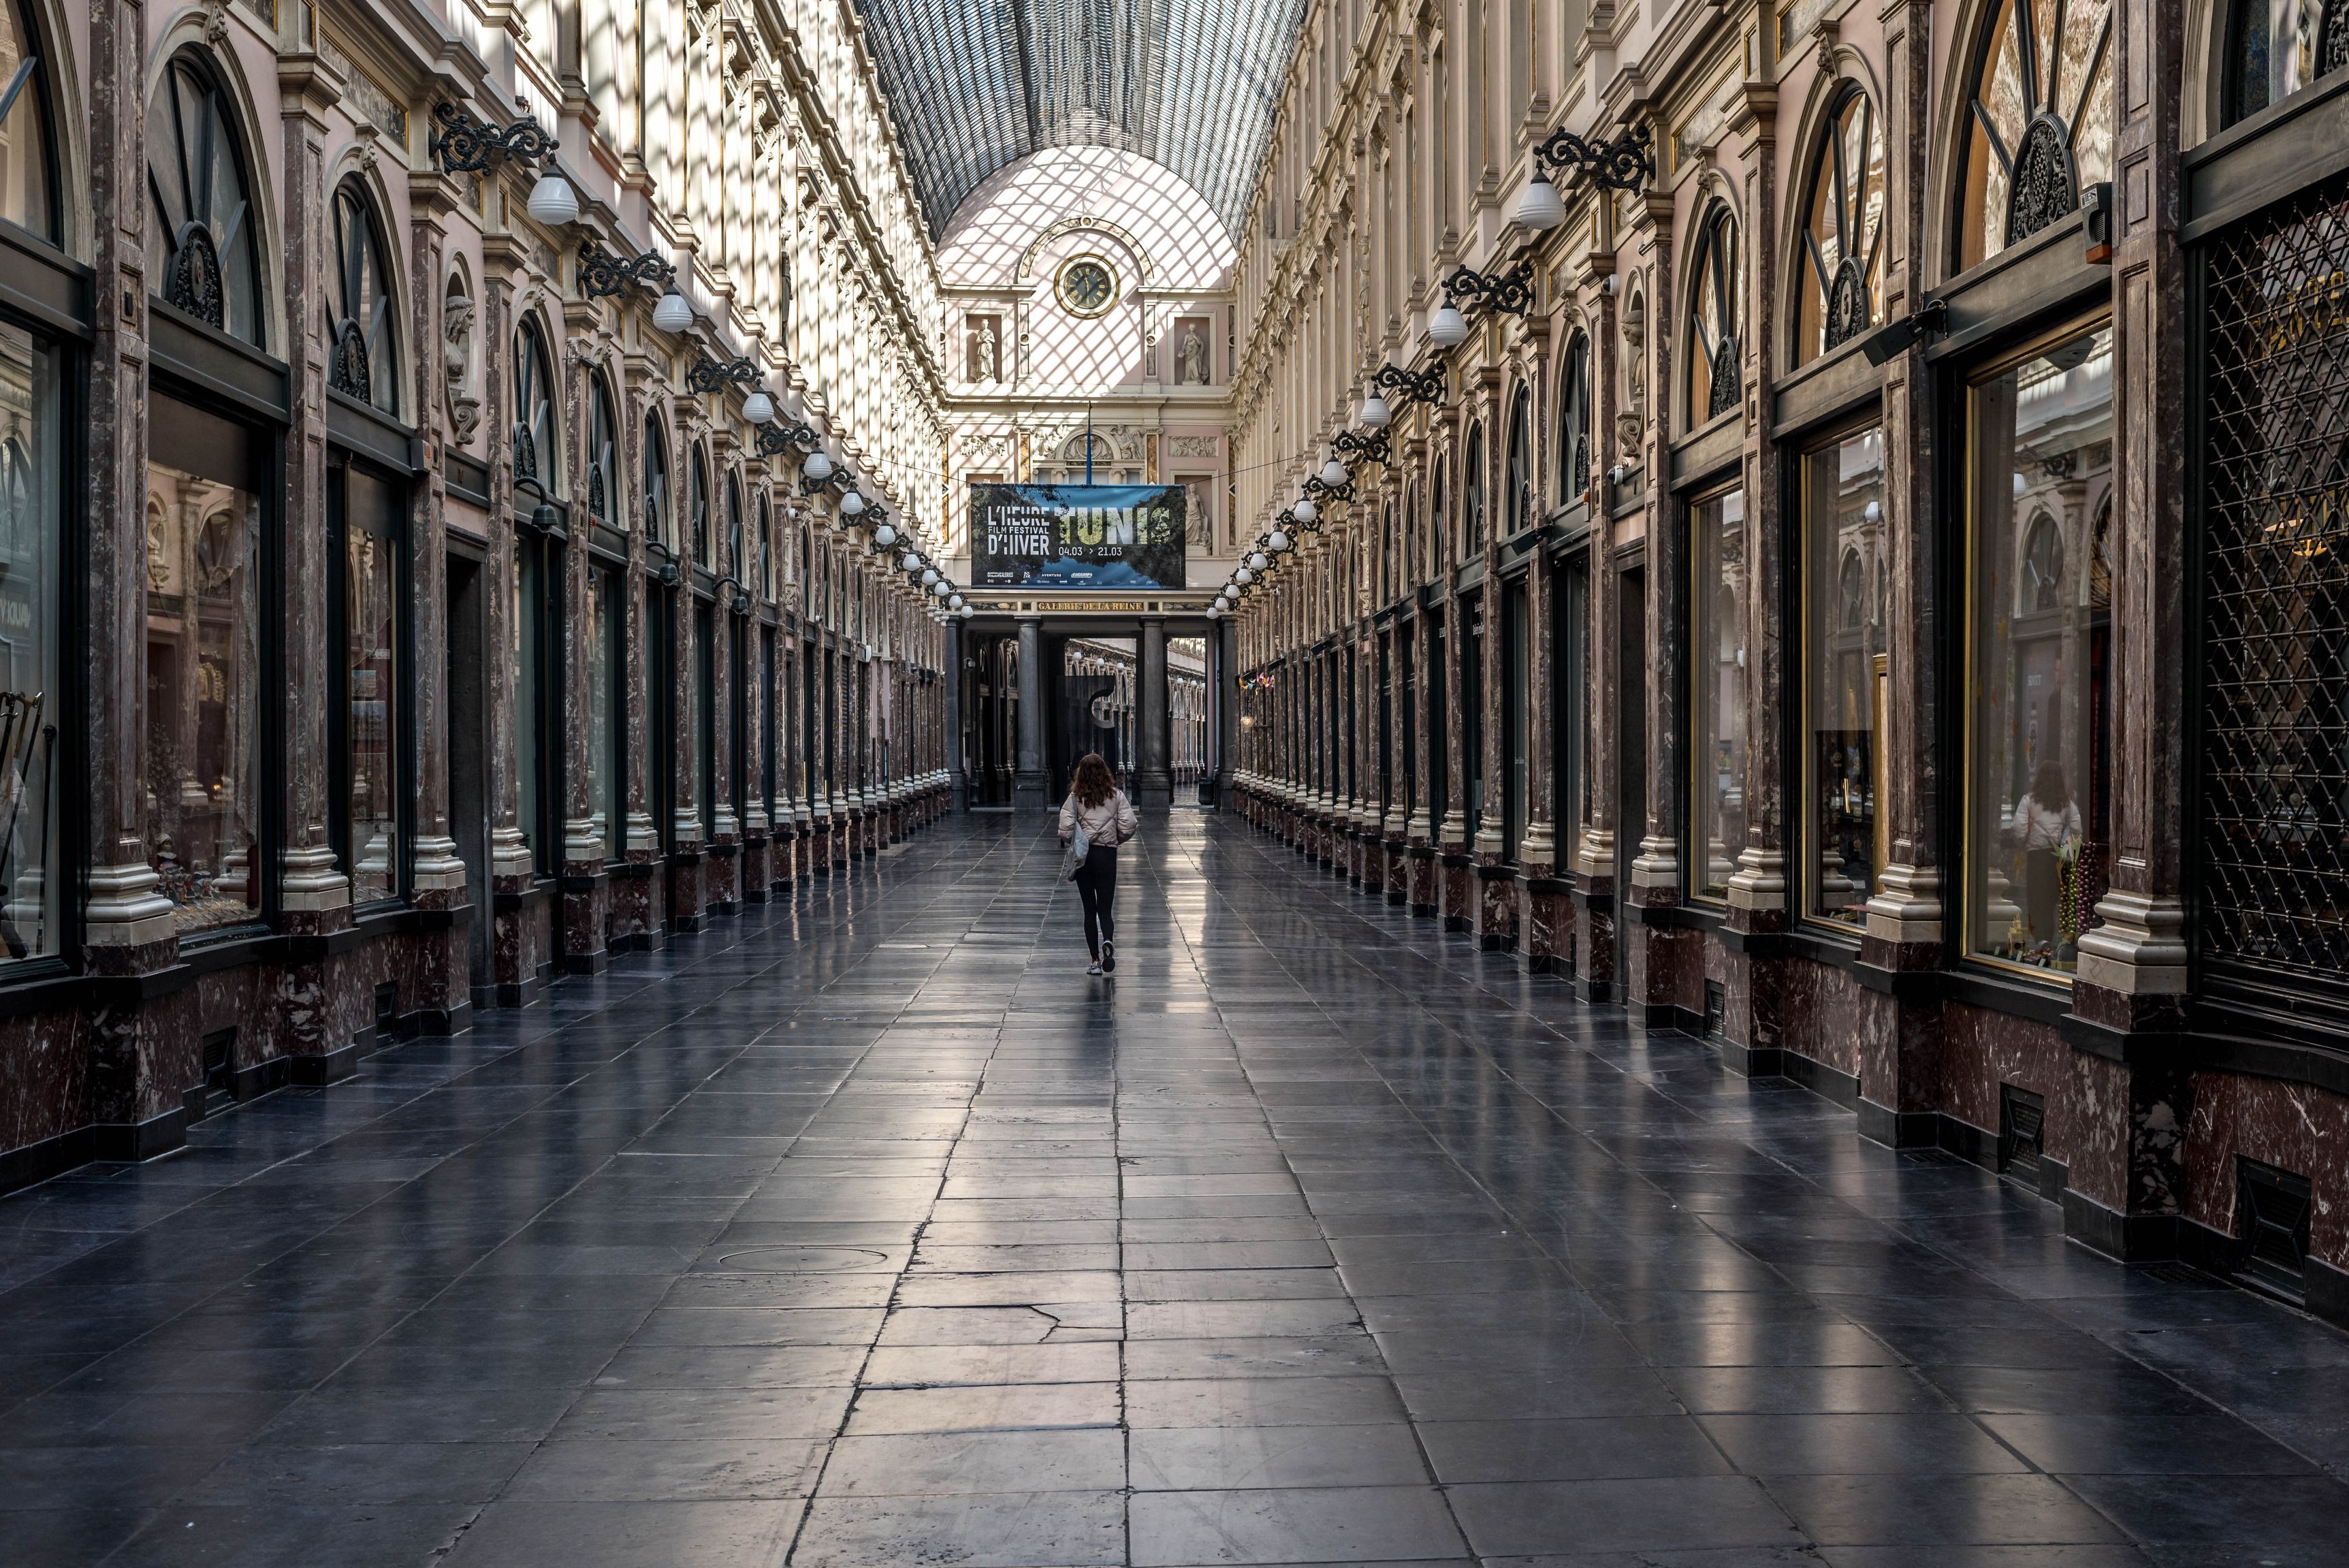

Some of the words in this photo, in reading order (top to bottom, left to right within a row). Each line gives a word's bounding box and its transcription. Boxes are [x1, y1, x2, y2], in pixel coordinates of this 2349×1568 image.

[1009, 526, 1049, 534] FESTIVAL
[1054, 507, 1170, 545] TUNIS
[1058, 547, 1083, 556] 04.03
[1098, 547, 1122, 556] 21.03
[1038, 603, 1080, 611] GALERIE
[1083, 603, 1096, 611] DE
[1098, 603, 1110, 611] LA
